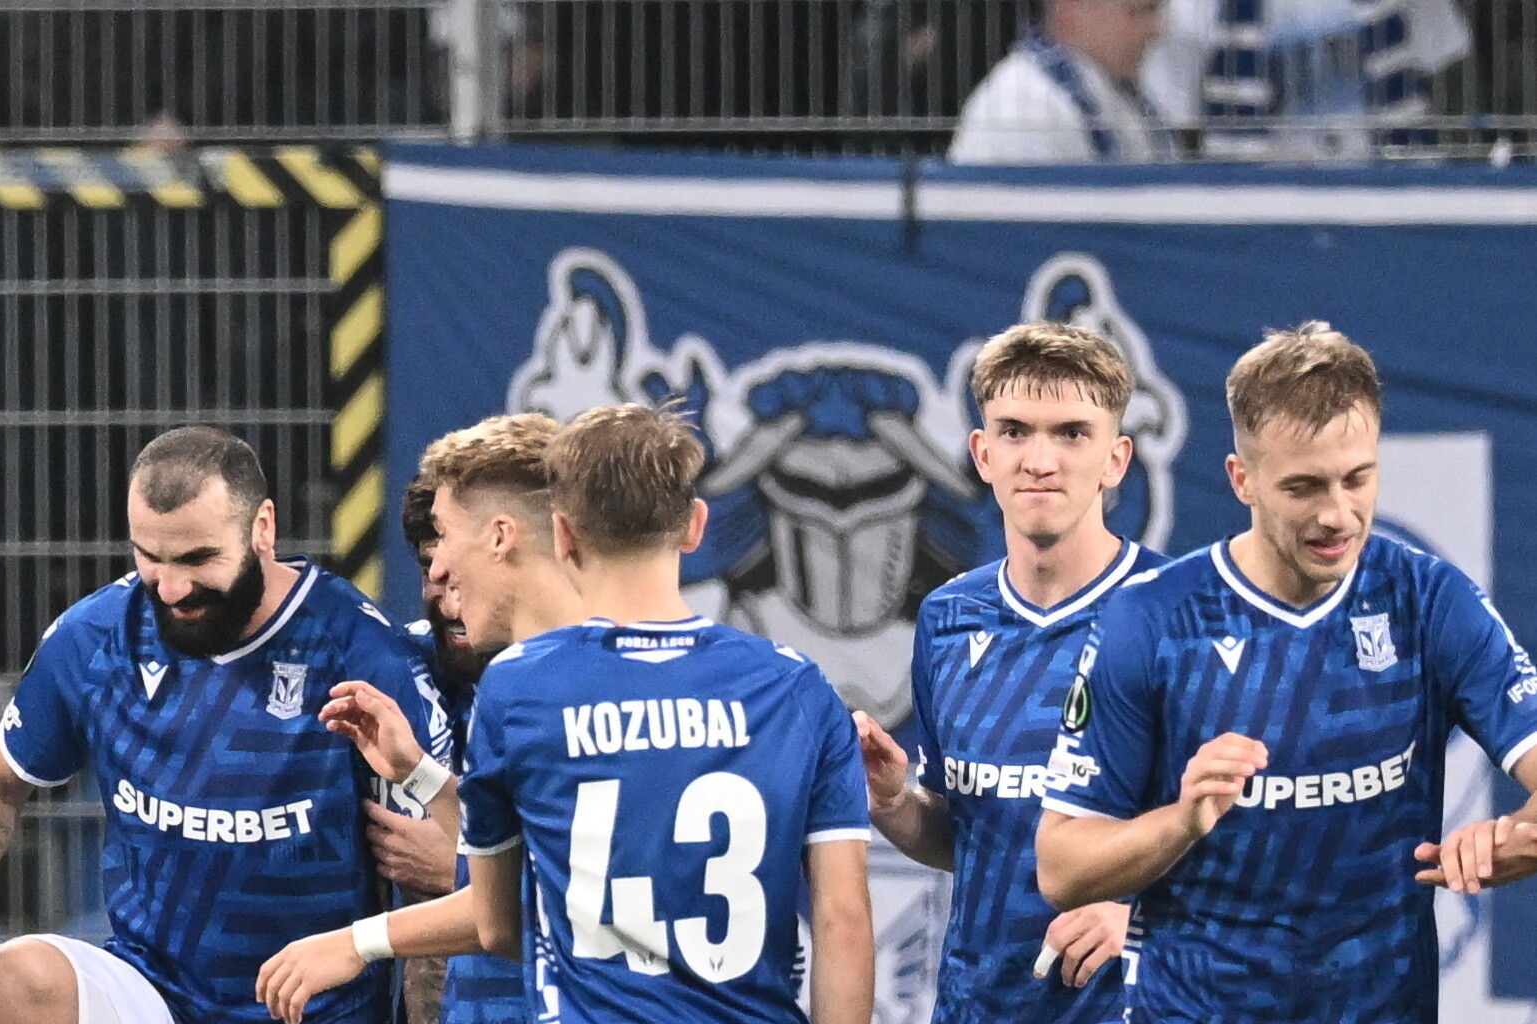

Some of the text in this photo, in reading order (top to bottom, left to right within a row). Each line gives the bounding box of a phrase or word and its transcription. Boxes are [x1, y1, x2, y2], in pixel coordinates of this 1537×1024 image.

[562, 697, 751, 758] KOZUBAL
[113, 779, 314, 844] SUPERBET
[565, 771, 767, 983] 43
